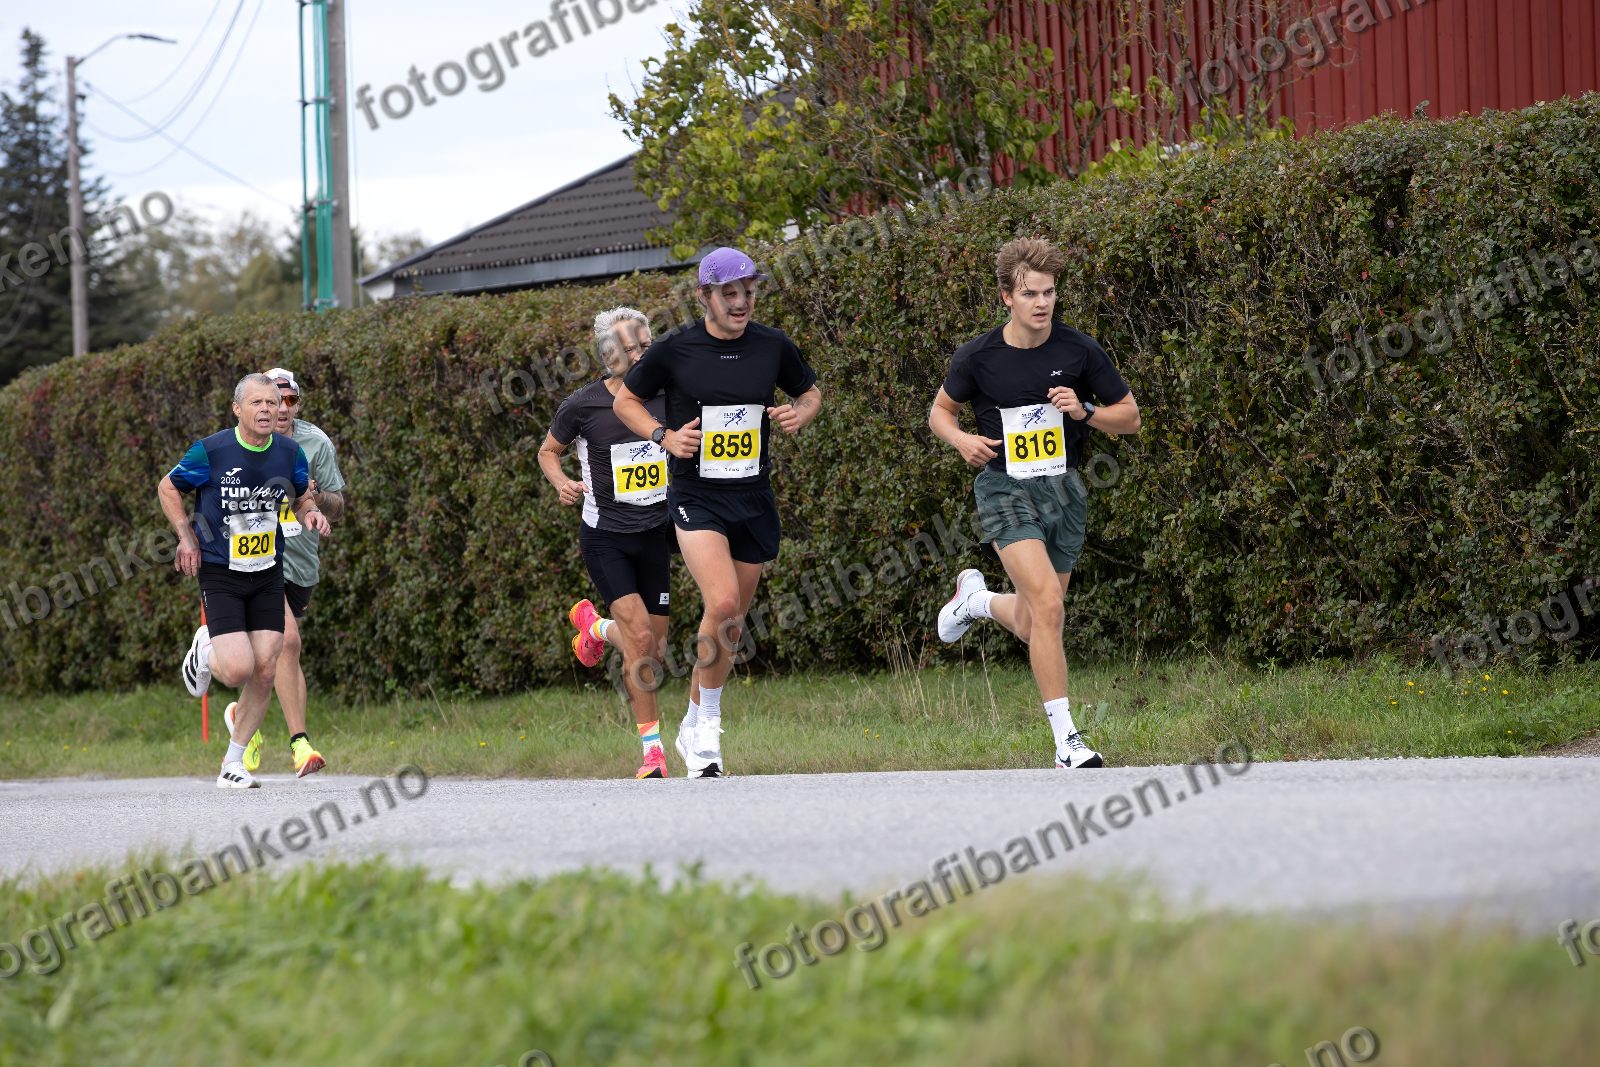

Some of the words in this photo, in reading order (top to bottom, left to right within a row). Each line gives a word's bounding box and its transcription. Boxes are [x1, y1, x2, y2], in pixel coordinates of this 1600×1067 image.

[711, 432, 752, 458] 859
[1015, 431, 1057, 459] 816
[220, 476, 241, 485] 2026
[621, 464, 660, 490] 799
[220, 486, 250, 498] run
[248, 485, 285, 501] your
[221, 498, 277, 511] record
[238, 533, 270, 556] 820
